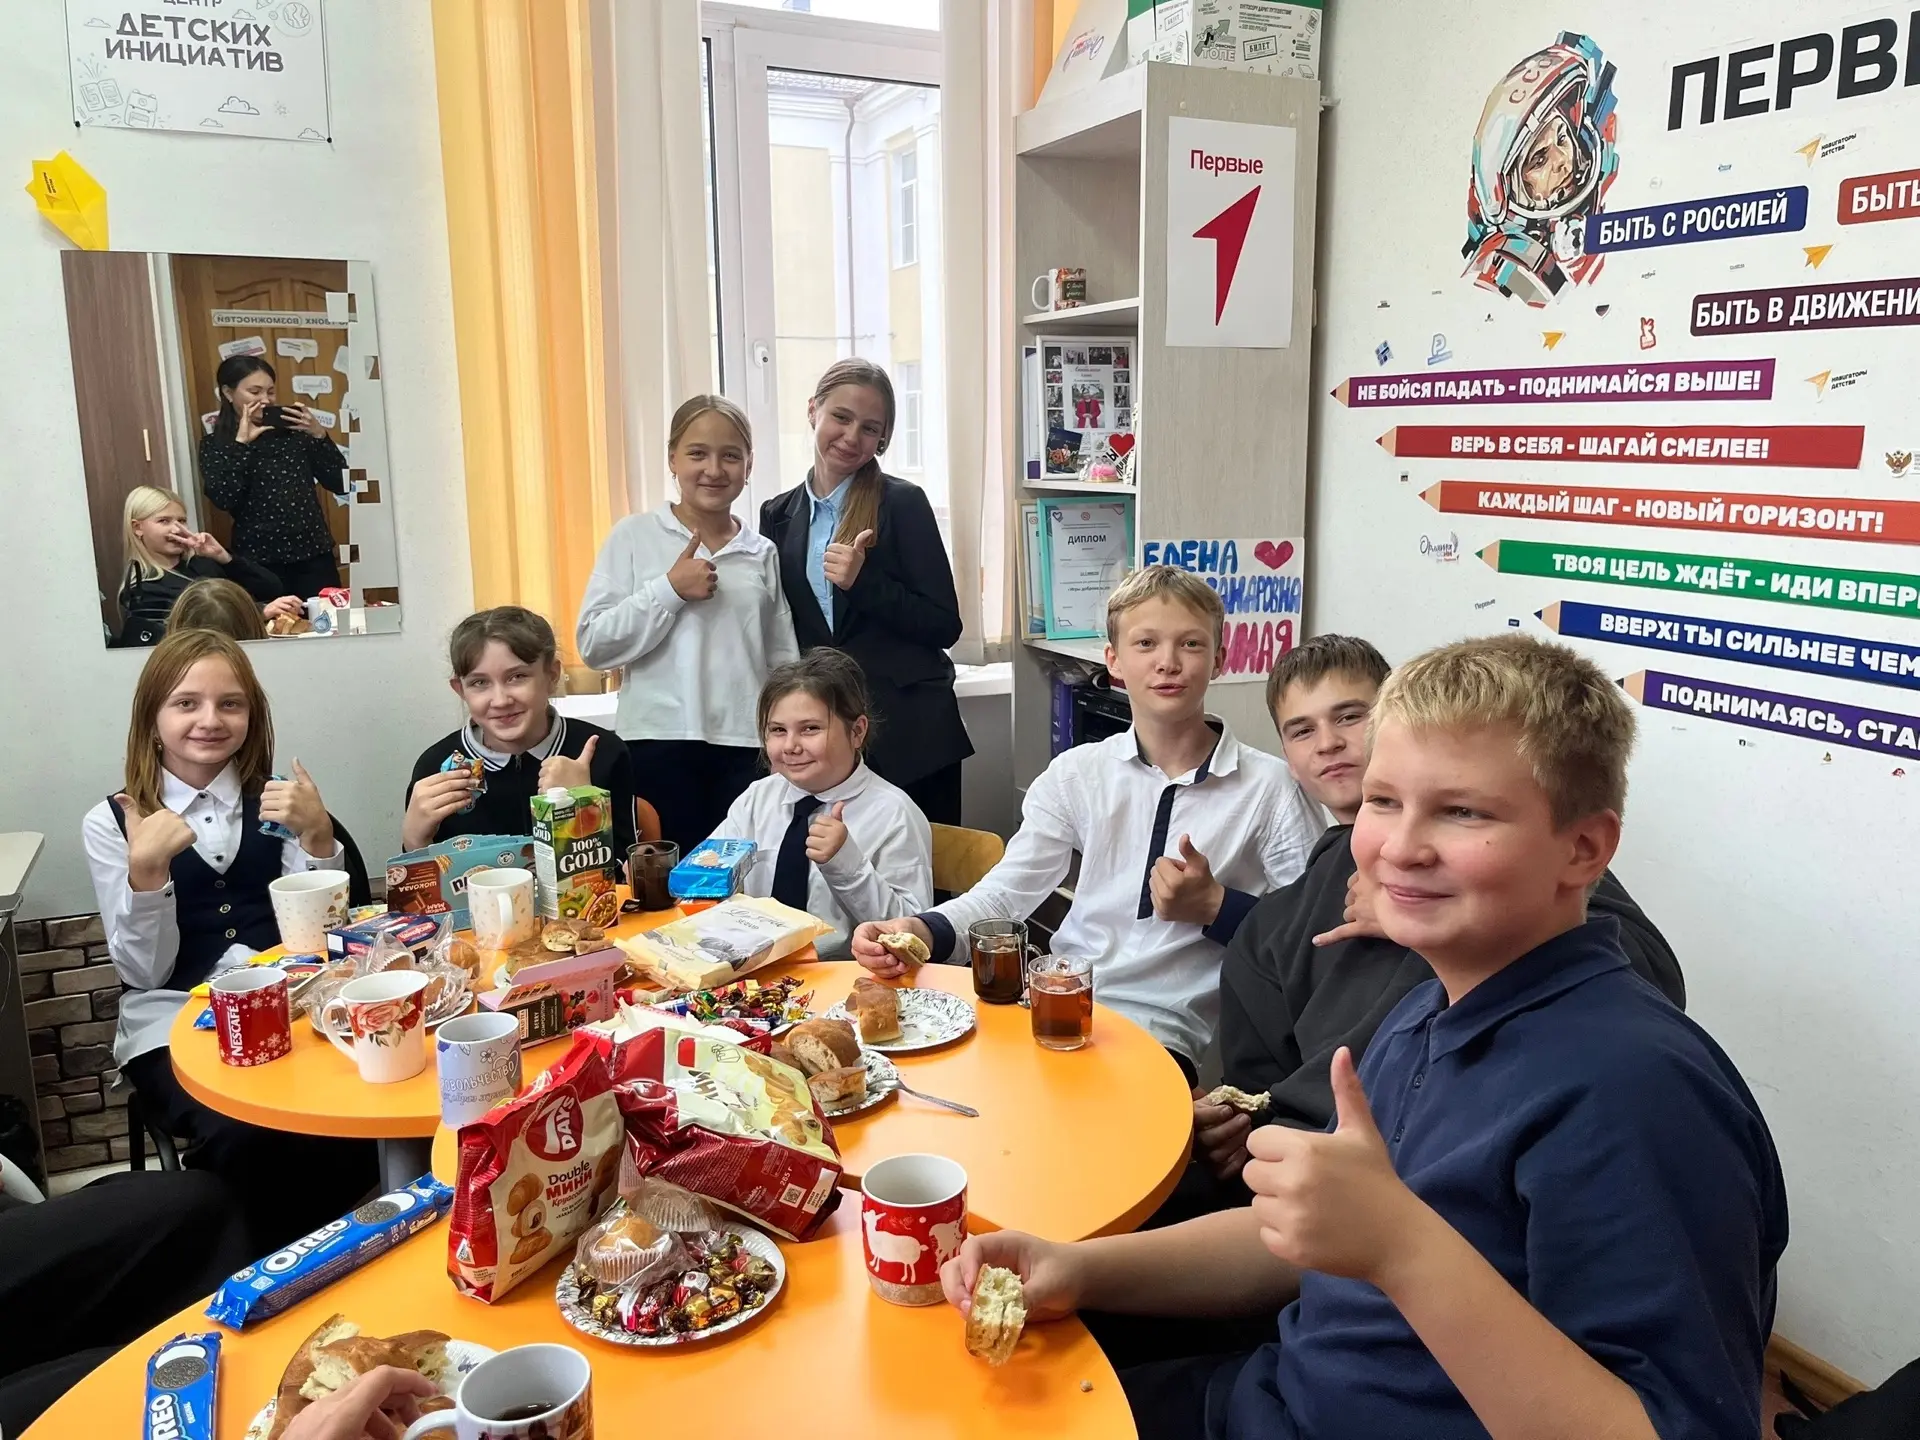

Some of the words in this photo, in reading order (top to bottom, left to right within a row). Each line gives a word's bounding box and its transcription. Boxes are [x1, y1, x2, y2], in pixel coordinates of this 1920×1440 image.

[116, 12, 272, 47] ДЕТСКИХ
[105, 38, 284, 73] ИНИЦИАТИВ
[1667, 10, 1920, 131] ПЕРВ
[1190, 149, 1264, 177] Первые
[1821, 144, 1846, 158] ДЕТСТВА
[1599, 215, 1656, 245] БЫТЬ
[1662, 211, 1676, 237] С
[1682, 192, 1788, 235] РОССИЕЙ
[1696, 298, 1760, 328] БЫТЬ
[1767, 296, 1783, 318] В
[1789, 286, 1920, 327] ДВИЖЕНИ
[1357, 384, 1377, 400] НЕ
[1379, 379, 1431, 399] БОЙСЯ
[1435, 378, 1505, 400] ПАДАТЬ
[1519, 368, 1669, 398] ПОДНИМАЙСЯ
[1674, 369, 1761, 393] ВЫШЕ!
[1831, 379, 1856, 390] ДЕТСТВА
[1451, 435, 1496, 453] ВЕРЬ
[1498, 436, 1511, 453] В
[1513, 436, 1563, 454] СЕБЯ
[1579, 431, 1657, 457] ШАГАЙ
[1661, 436, 1770, 459] СМЕЛЕЕ!
[1478, 490, 1569, 514] КАЖДЫЙ
[1573, 496, 1619, 516] ШАГ
[1635, 497, 1725, 523] НОВЫЙ
[1729, 503, 1884, 533] ГОРИЗОНТ!
[1067, 534, 1107, 546] ДИПЛОМ
[1552, 553, 1606, 576] ТВОЯ
[1609, 558, 1671, 582] ЦЕЛЬ
[1674, 562, 1751, 590] ЖДЁТ
[1770, 572, 1833, 600] ИДИ
[1838, 580, 1920, 610] ВПЕР
[1600, 613, 1680, 641] ВВЕРХ!
[1684, 624, 1721, 648] ТЫ
[1726, 629, 1855, 667] СИЛЬНЕЕ
[1860, 648, 1920, 677] ЧЕМ
[1661, 683, 1853, 738] ПОДНИМАЯСЬ,
[1857, 719, 1920, 751] СТА
[533, 828, 552, 842] GOLD
[572, 837, 602, 853] 100%
[560, 846, 612, 874] GOLD
[399, 880, 437, 892] ШОКОЛАД
[555, 1096, 577, 1150] DAYS
[546, 1168, 593, 1200] МИНИ
[548, 1160, 591, 1185] Double
[263, 1219, 350, 1274] OREO
[150, 1393, 180, 1440] REO
